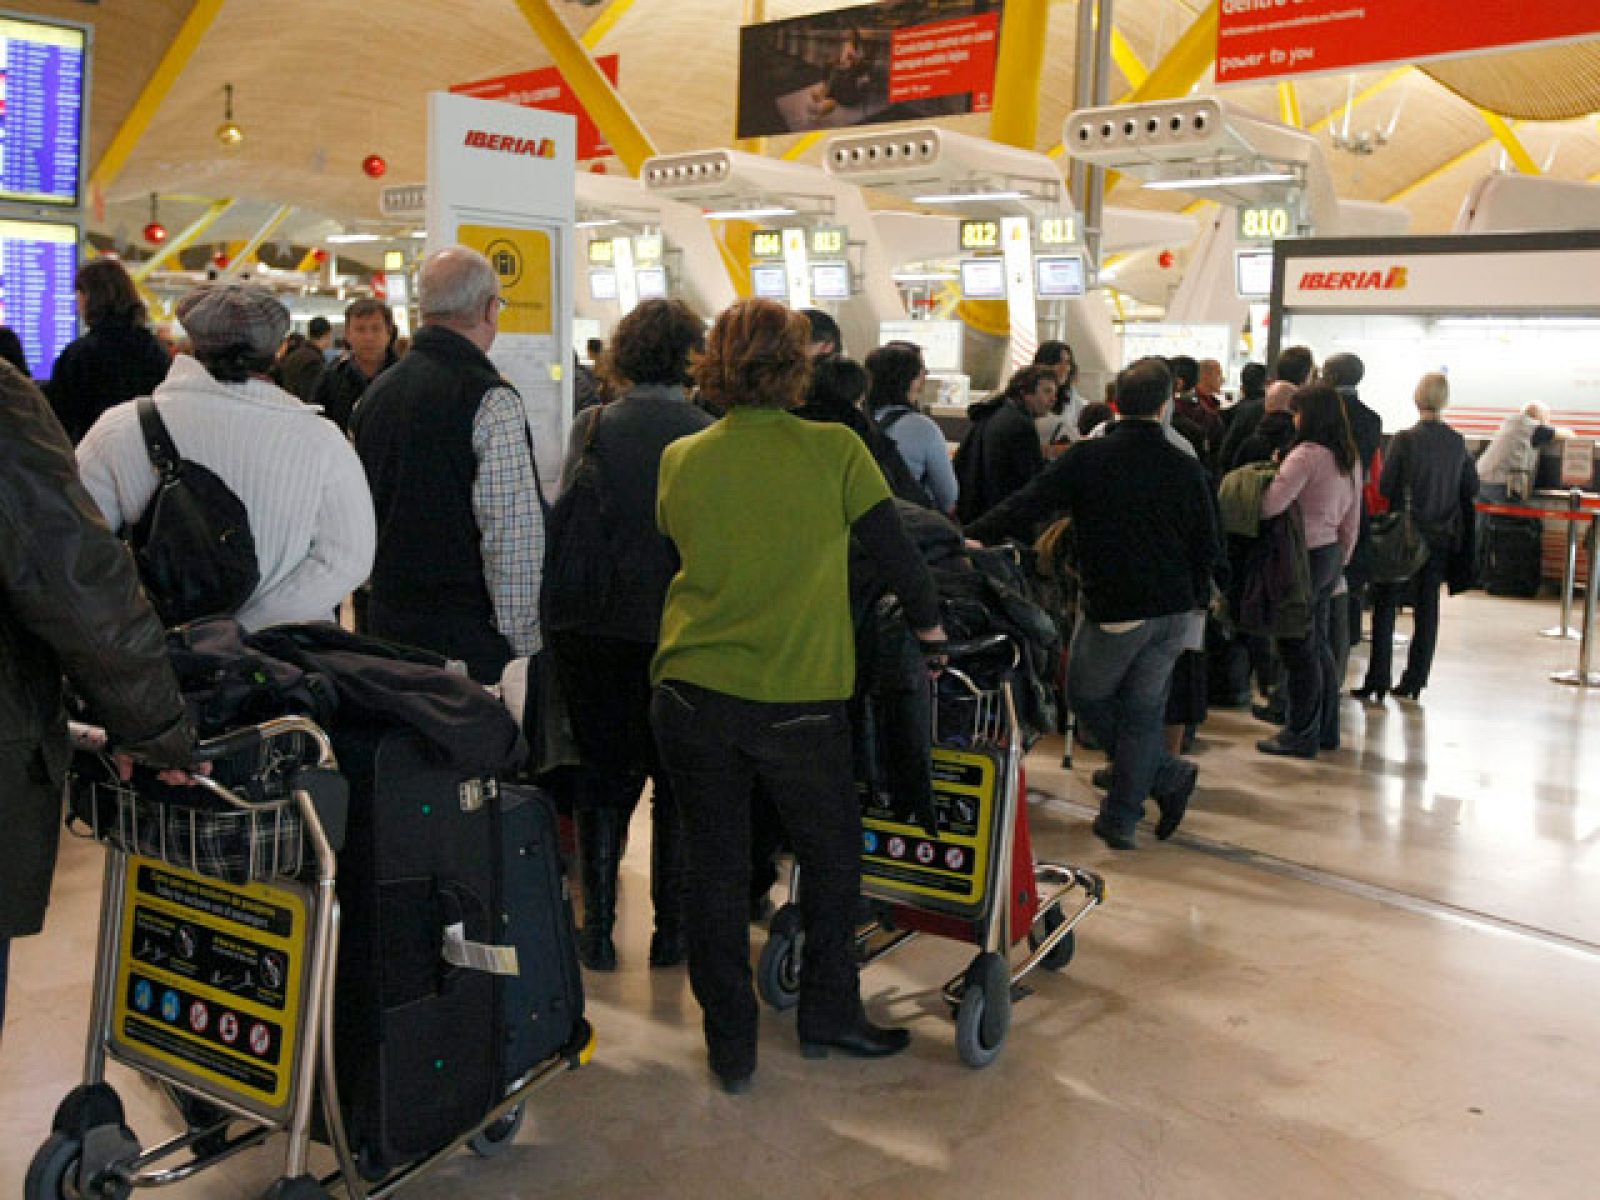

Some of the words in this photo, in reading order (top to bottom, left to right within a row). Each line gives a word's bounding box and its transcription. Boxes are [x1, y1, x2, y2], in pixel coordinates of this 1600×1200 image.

[1220, 53, 1265, 74] power
[1270, 49, 1286, 64] to
[1289, 48, 1315, 67] you
[464, 129, 538, 156] IBERIA
[963, 222, 997, 247] 812
[1041, 219, 1075, 243] 811
[1242, 208, 1288, 236] 810
[1299, 270, 1382, 291] IBERIA
